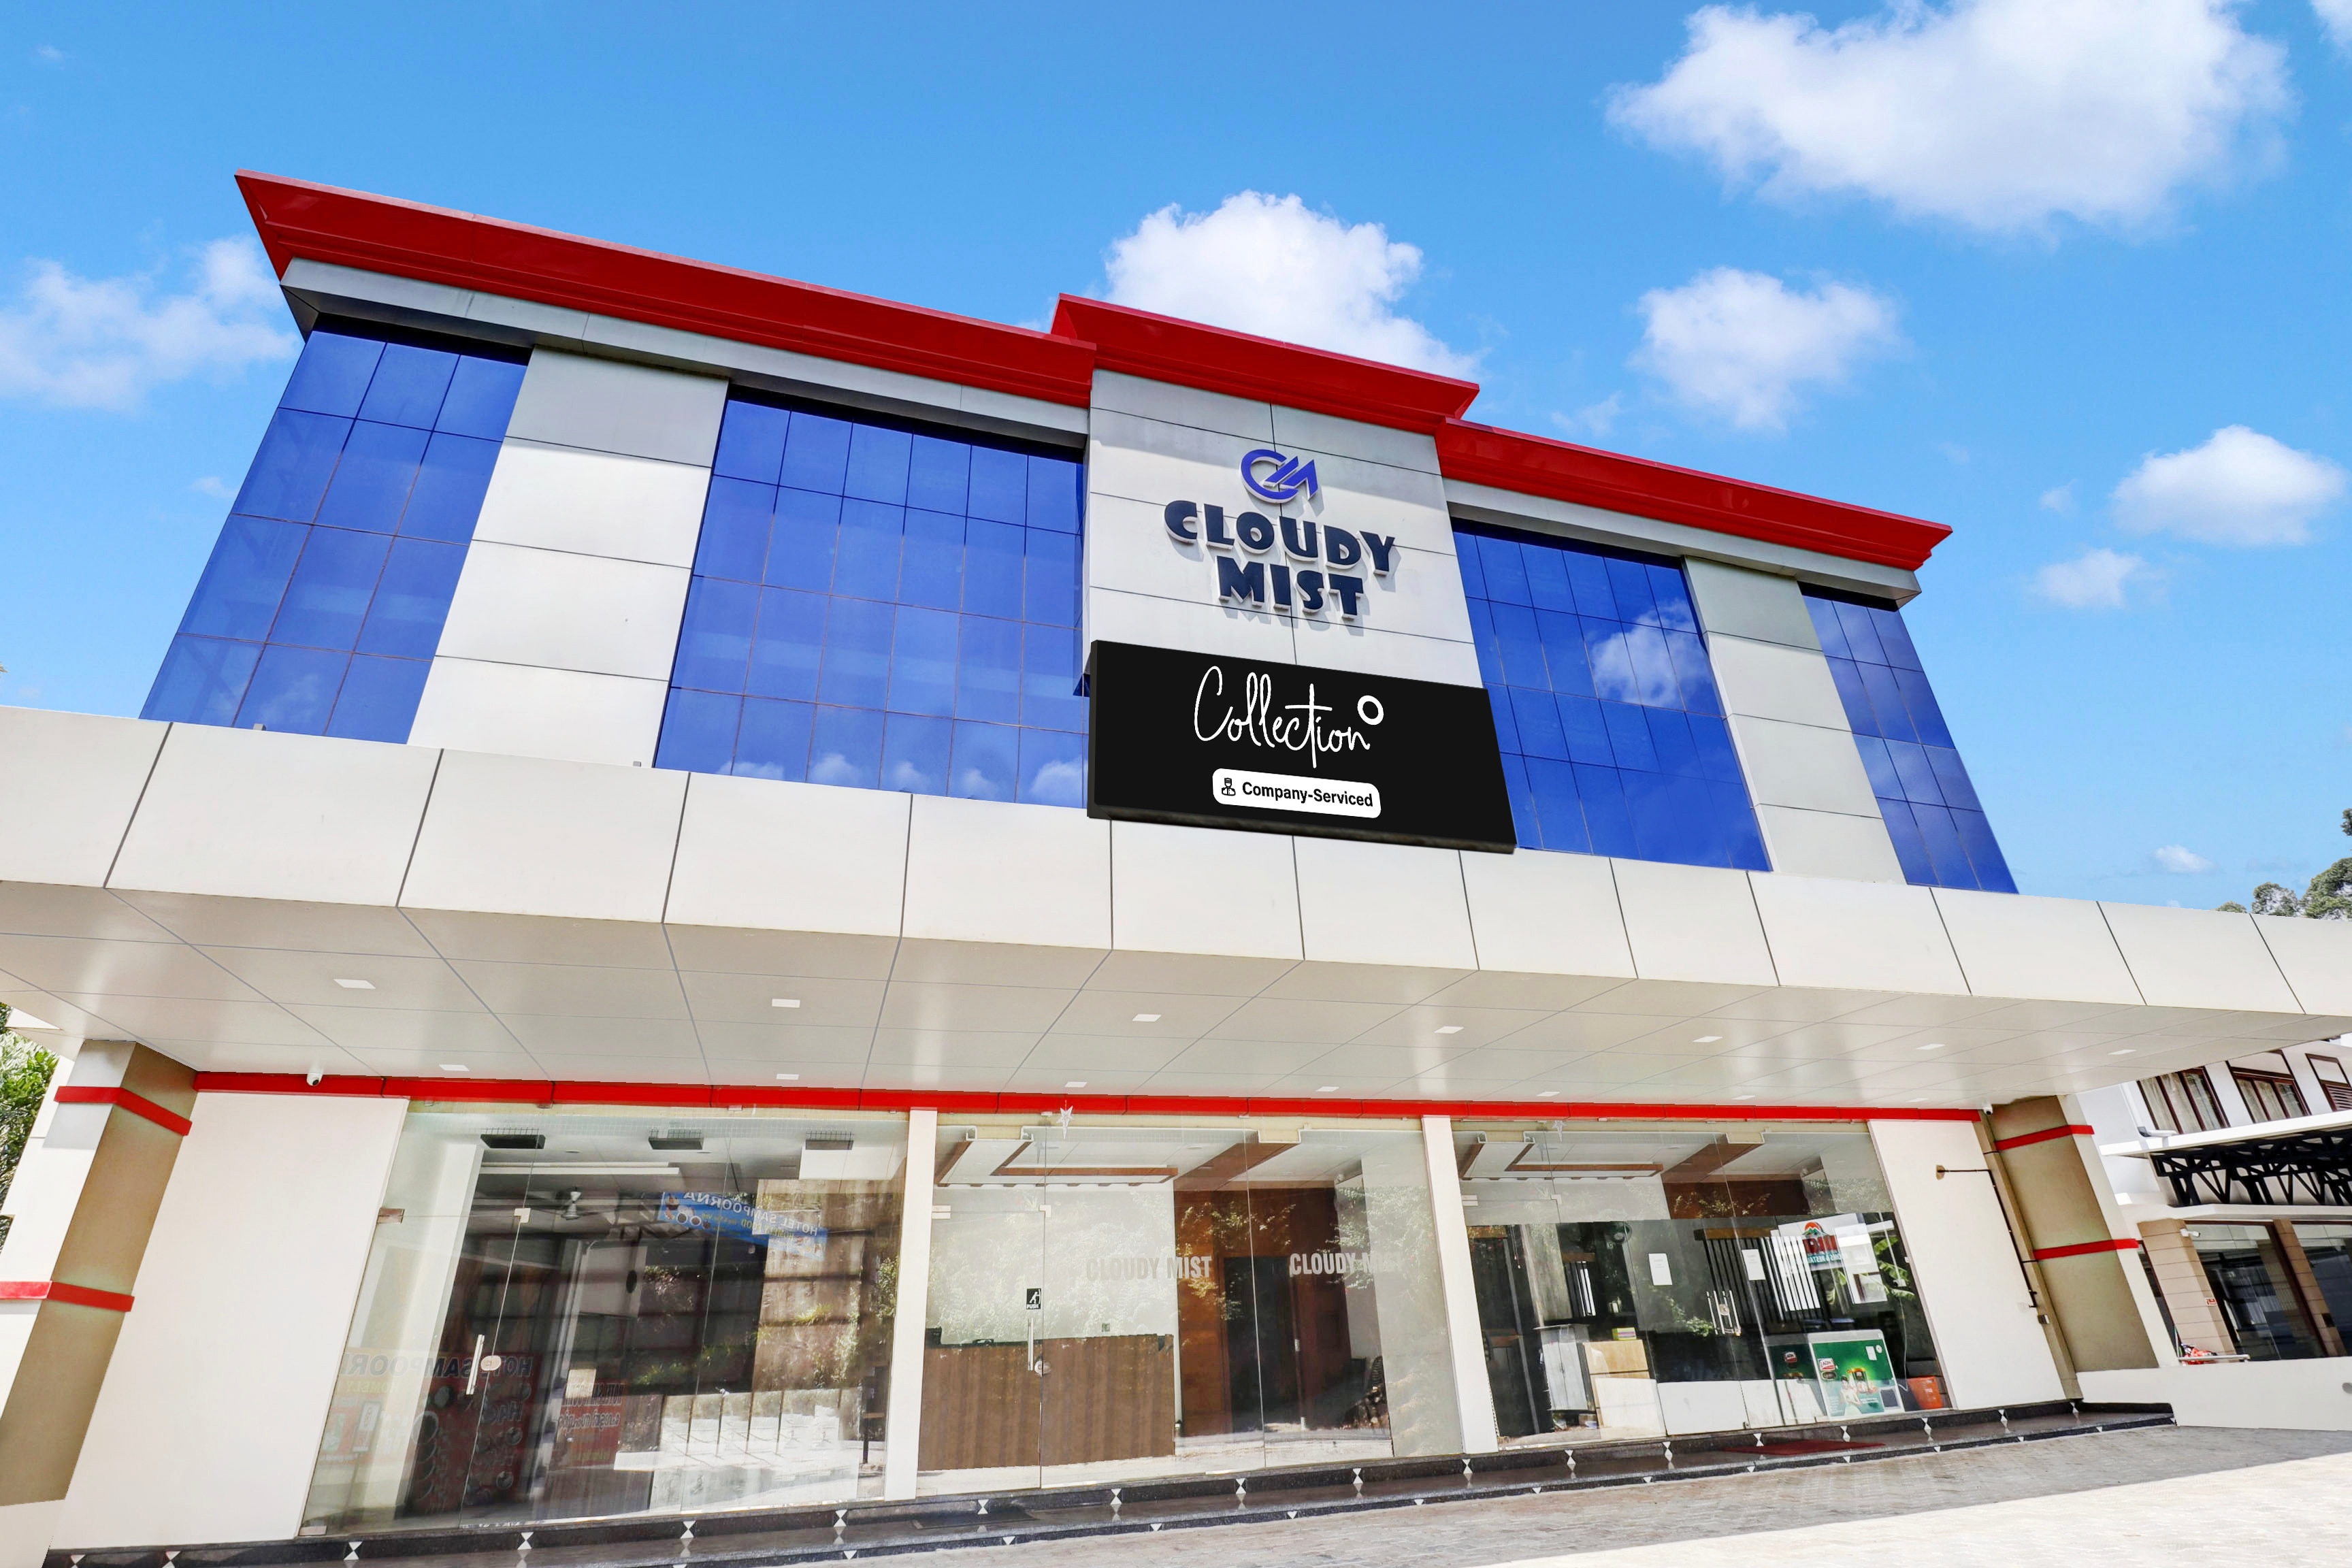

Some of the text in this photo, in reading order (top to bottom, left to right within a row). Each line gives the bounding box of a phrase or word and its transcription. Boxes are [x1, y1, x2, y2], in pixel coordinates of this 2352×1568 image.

[1164, 500, 1396, 574] CLOUDY
[1215, 556, 1364, 619] MIST
[1194, 666, 1371, 768] Collection
[1242, 781, 1373, 808] Company-Serviced
[1086, 1256, 1212, 1281] CLOUDY MIST
[1290, 1252, 1356, 1276] CLOUDY
